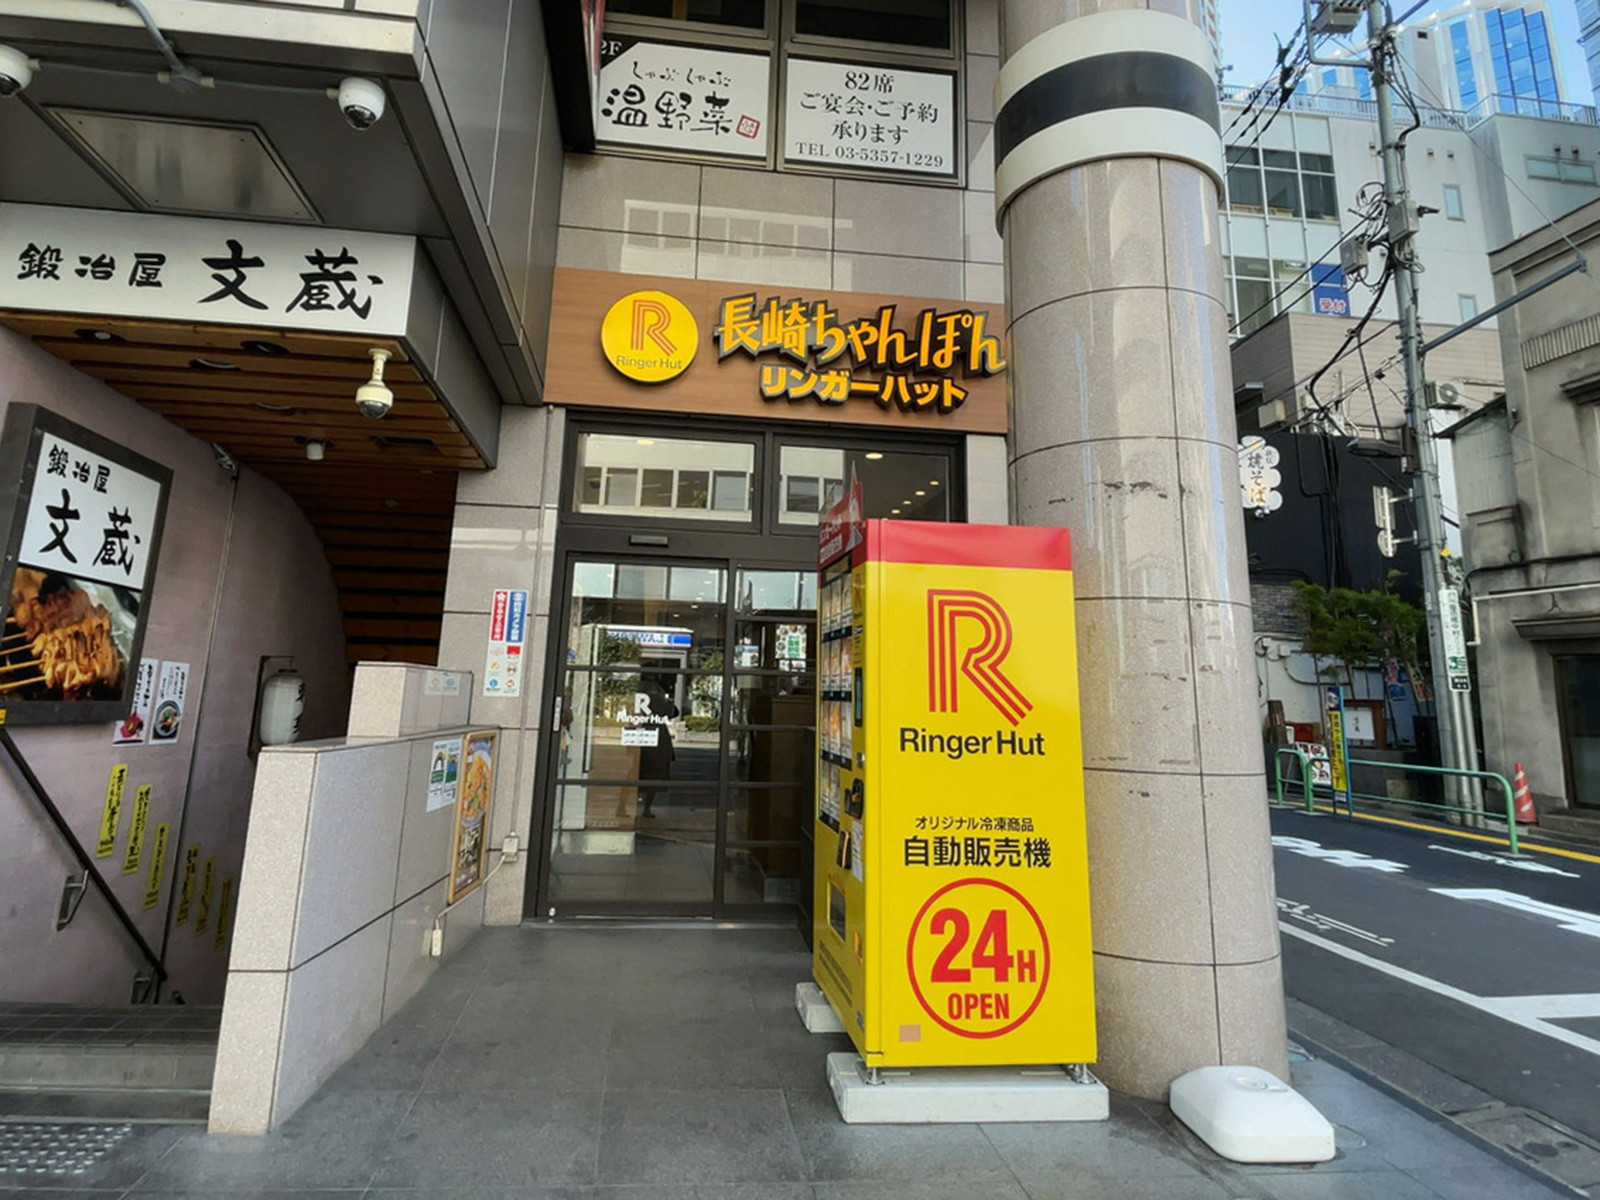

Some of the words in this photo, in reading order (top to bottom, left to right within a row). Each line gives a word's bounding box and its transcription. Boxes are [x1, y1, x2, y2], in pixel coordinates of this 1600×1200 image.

[844, 71, 895, 94] 82席
[601, 84, 733, 135] 温野菜
[831, 120, 909, 145] 承ります
[795, 142, 829, 158] TEL
[835, 145, 944, 168] 03-5357-1229
[16, 243, 167, 288] 鍛冶屋
[197, 239, 383, 320] 文蔵
[716, 295, 1006, 375] 長崎ちゃんぽん
[616, 355, 657, 371] Ringer
[659, 358, 683, 371] Hut
[763, 365, 967, 408] リンガーハット
[47, 443, 111, 494] 鍛冶屋
[39, 488, 141, 575] 文蔵
[899, 726, 992, 759] Ringer
[996, 730, 1046, 757] Hut
[914, 816, 1035, 833] オリジナル冷凍商品
[903, 836, 1052, 868] 自動販売機
[930, 907, 1037, 984] 24H
[947, 992, 1011, 1021] OPEN
